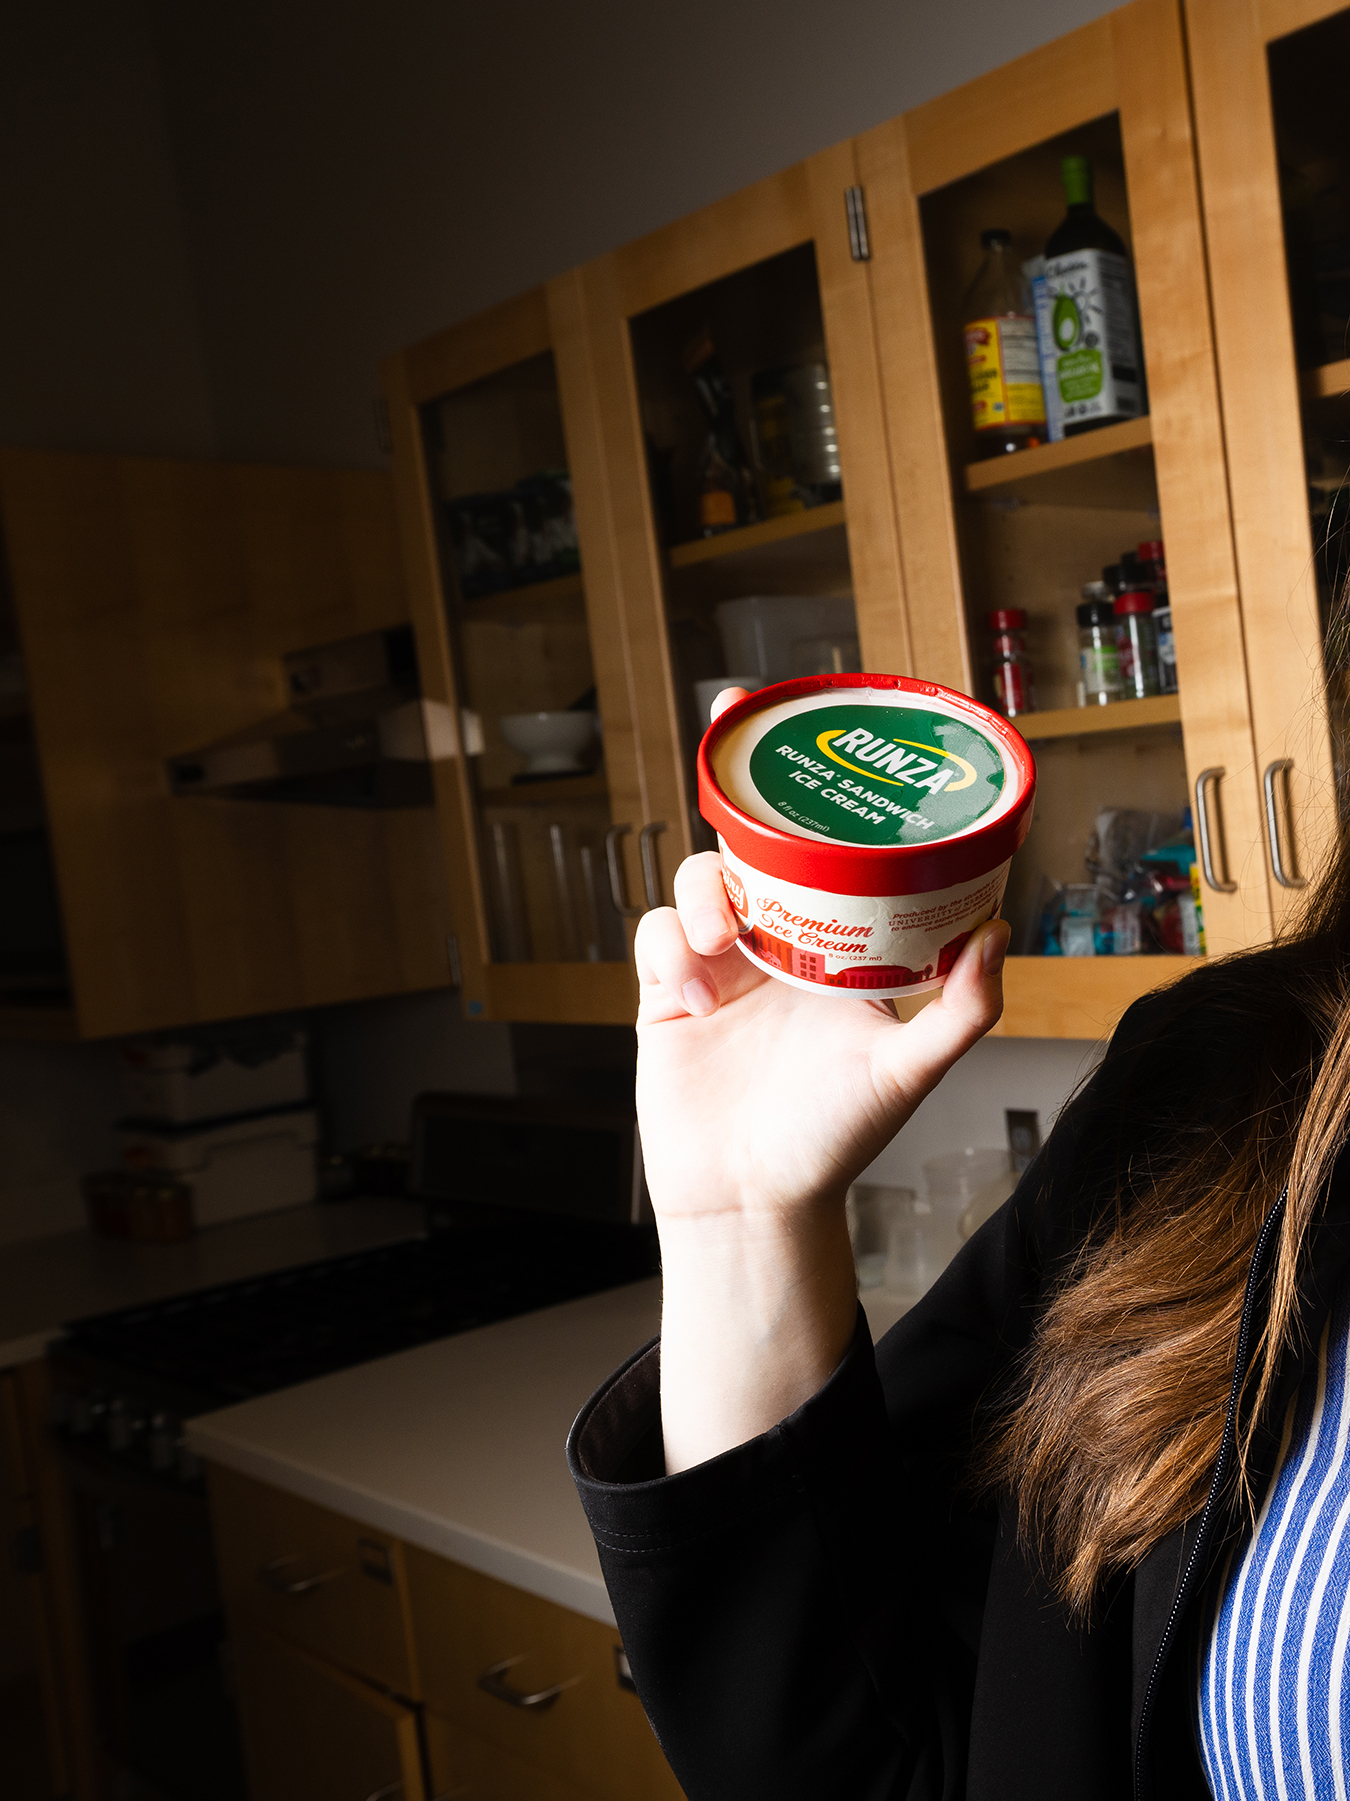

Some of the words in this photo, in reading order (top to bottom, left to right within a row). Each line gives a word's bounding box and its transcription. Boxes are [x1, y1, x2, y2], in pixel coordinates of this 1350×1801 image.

[832, 727, 954, 795] RUNZA
[789, 770, 823, 790] ICE
[820, 788, 886, 825] CREAM
[837, 779, 935, 830] SANDWICH
[788, 808, 799, 818] oz
[756, 897, 875, 938] Premium
[889, 909, 952, 926] UNIVERSITY
[893, 906, 937, 919] Produced
[938, 902, 948, 911] by
[950, 899, 962, 907] the
[758, 913, 793, 938] Ice
[798, 929, 868, 954] Cream
[901, 920, 933, 930] enhance
[924, 919, 954, 932] students
